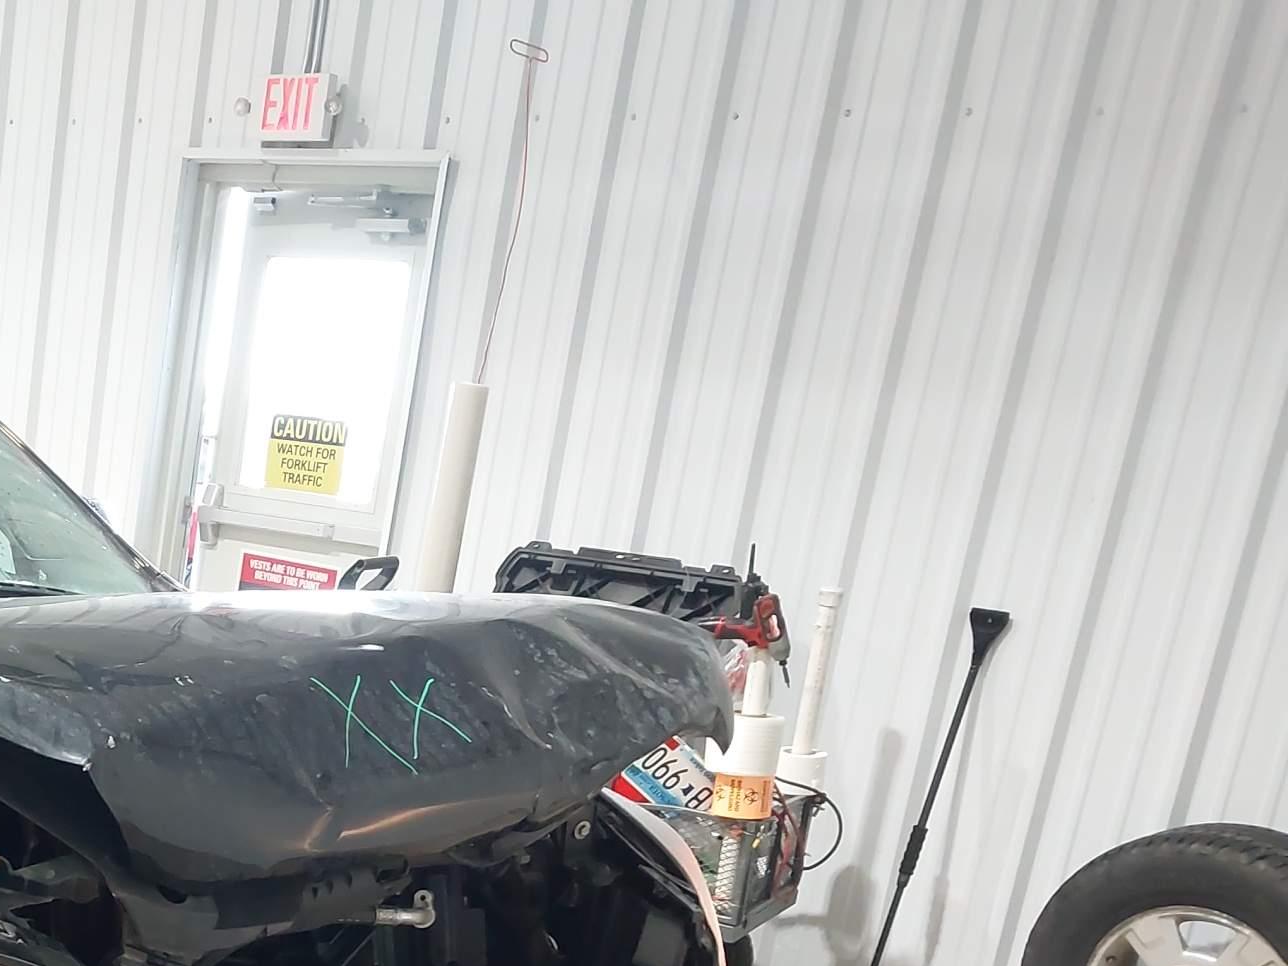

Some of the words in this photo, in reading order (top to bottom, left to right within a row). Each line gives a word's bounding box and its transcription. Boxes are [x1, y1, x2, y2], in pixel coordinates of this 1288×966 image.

[262, 77, 319, 131] EXIT
[272, 415, 345, 444] CAUTION
[276, 443, 313, 458] WATCH
[315, 447, 337, 460] FOR
[280, 457, 328, 474] FORKLIFT
[282, 471, 323, 488] TRAFFIC
[249, 559, 272, 571] VESTS
[271, 563, 286, 575] ARE
[286, 566, 296, 577] TO
[295, 568, 306, 578] BE
[254, 570, 283, 583] BEYOND
[282, 575, 298, 587] THIS
[298, 579, 321, 590] POINT
